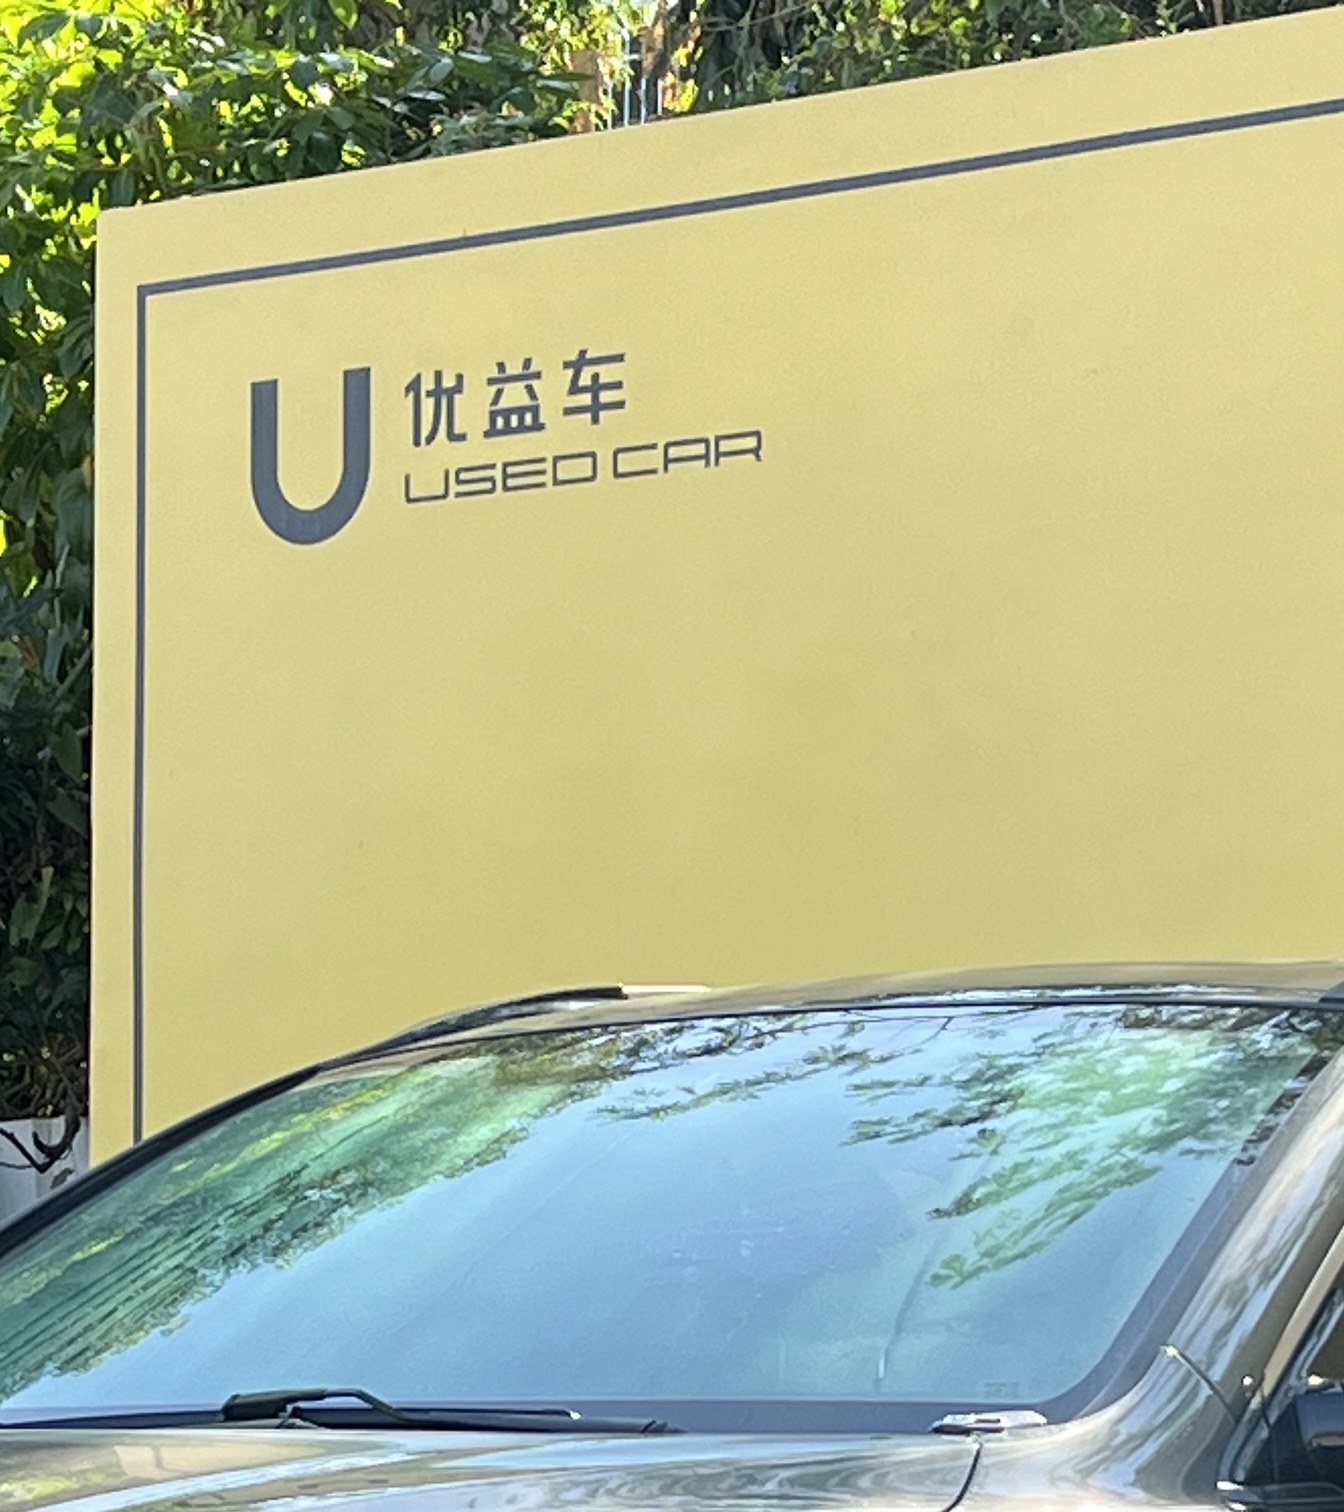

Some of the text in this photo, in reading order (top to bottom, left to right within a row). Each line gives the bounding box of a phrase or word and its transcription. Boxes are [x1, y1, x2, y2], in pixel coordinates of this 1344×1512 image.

[404, 349, 625, 447] 优益车
[251, 367, 370, 545] U
[405, 430, 761, 504] USED CAR
